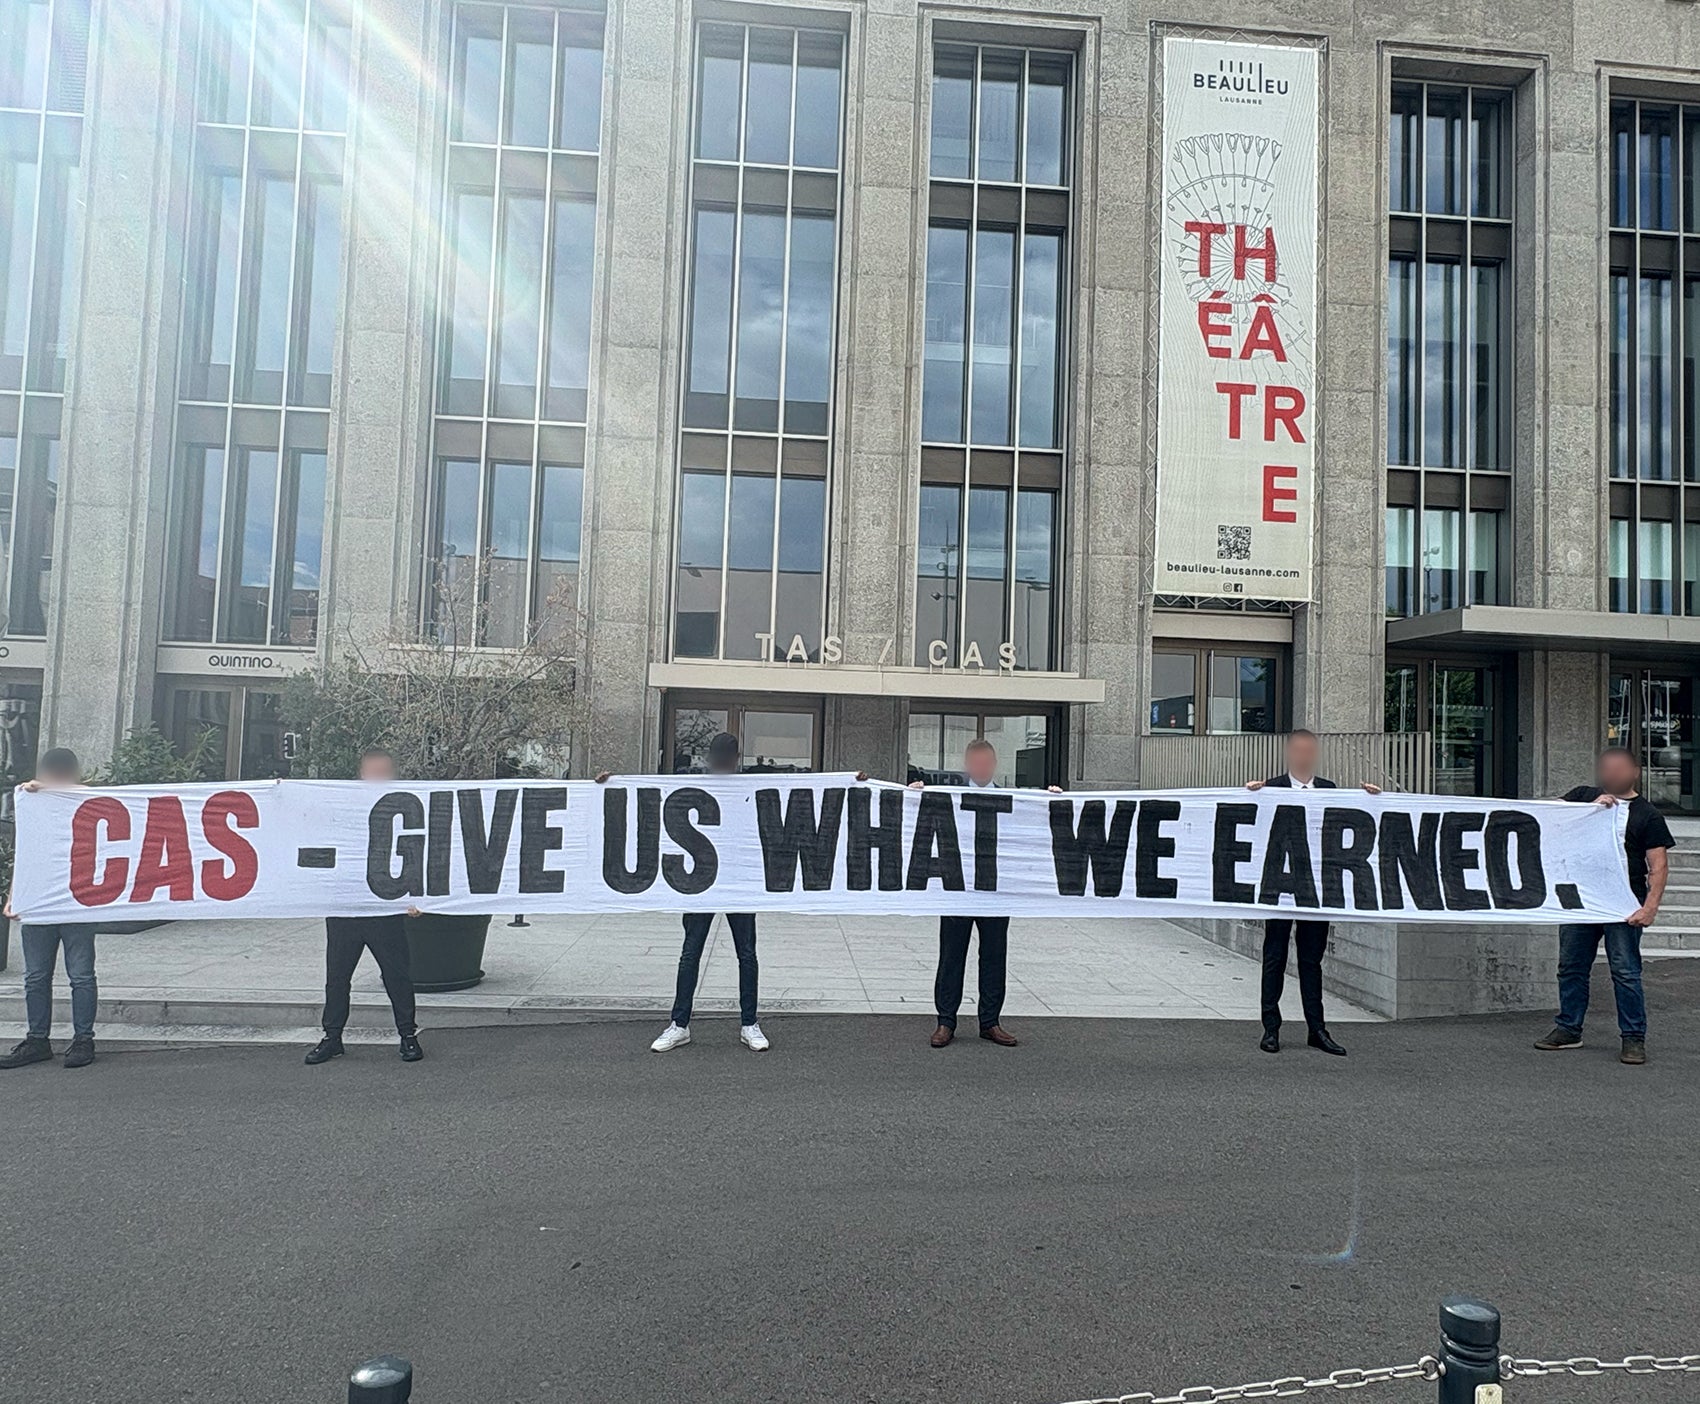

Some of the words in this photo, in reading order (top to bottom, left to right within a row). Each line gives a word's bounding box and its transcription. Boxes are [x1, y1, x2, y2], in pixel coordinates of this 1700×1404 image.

[1193, 63, 1289, 95] BEAULIEU
[1219, 96, 1263, 105] LAUSANNE
[1185, 221, 1277, 283] TH
[1215, 382, 1307, 443] TR
[1262, 465, 1298, 523] E
[1167, 562, 1300, 578] beaulieu-lausanne.com
[208, 655, 273, 669] QUINTINO
[755, 633, 842, 662] TAS
[928, 640, 1017, 669] CAS
[69, 790, 260, 908] CAS
[366, 787, 567, 900] GIVE
[602, 787, 720, 895] US
[756, 787, 1013, 893] WHAT
[1048, 799, 1181, 898] WE
[1213, 802, 1584, 911] EARNED.
